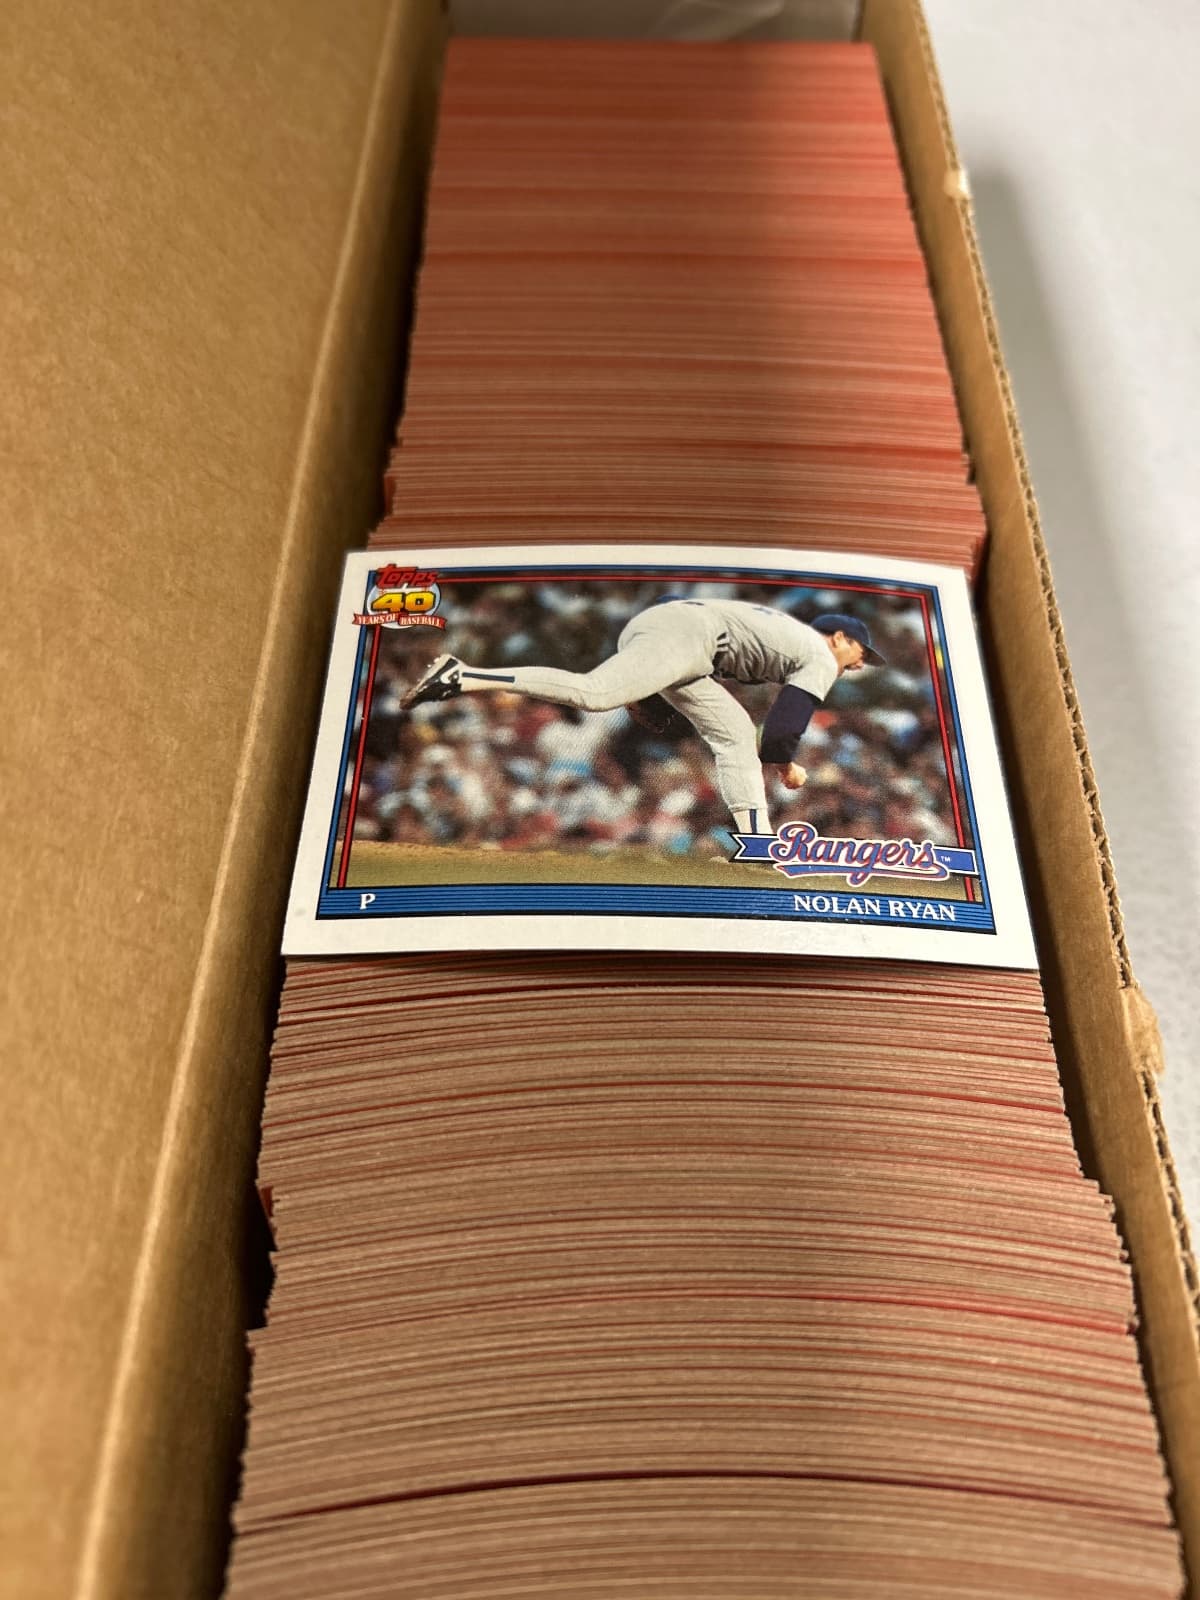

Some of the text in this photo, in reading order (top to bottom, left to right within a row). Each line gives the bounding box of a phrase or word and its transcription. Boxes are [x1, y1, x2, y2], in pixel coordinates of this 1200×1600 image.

[371, 591, 436, 613] 40
[358, 613, 442, 627] YEARS OF BASEBALL
[769, 821, 949, 887] Rangers
[360, 893, 376, 910] P
[793, 894, 956, 921] NOLAN RYAN
